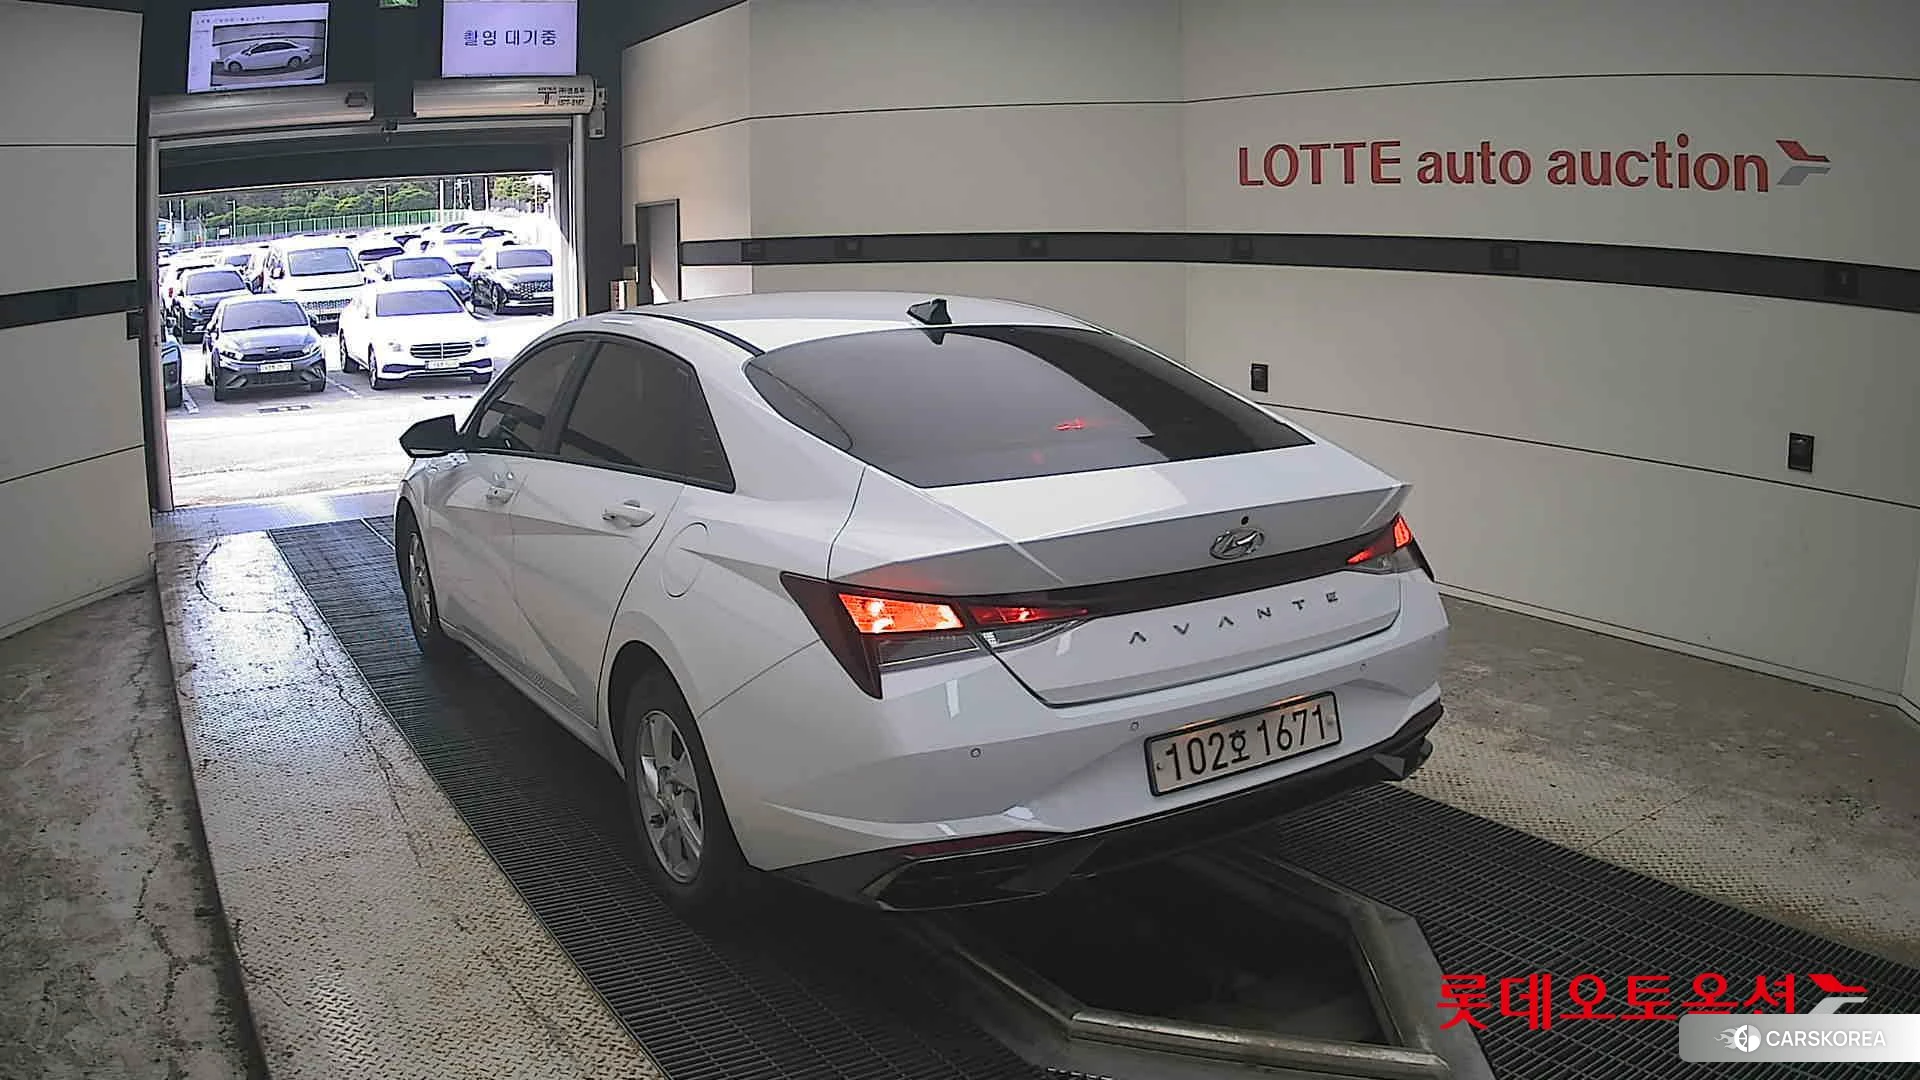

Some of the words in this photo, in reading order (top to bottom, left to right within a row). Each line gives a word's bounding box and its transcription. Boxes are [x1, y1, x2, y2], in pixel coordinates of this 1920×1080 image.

[505, 29, 557, 46] 대기중
[1239, 139, 1401, 187] LOTTE
[1416, 141, 1532, 186] auto
[1547, 133, 1769, 193] auction
[1129, 591, 1339, 645] AVANTE
